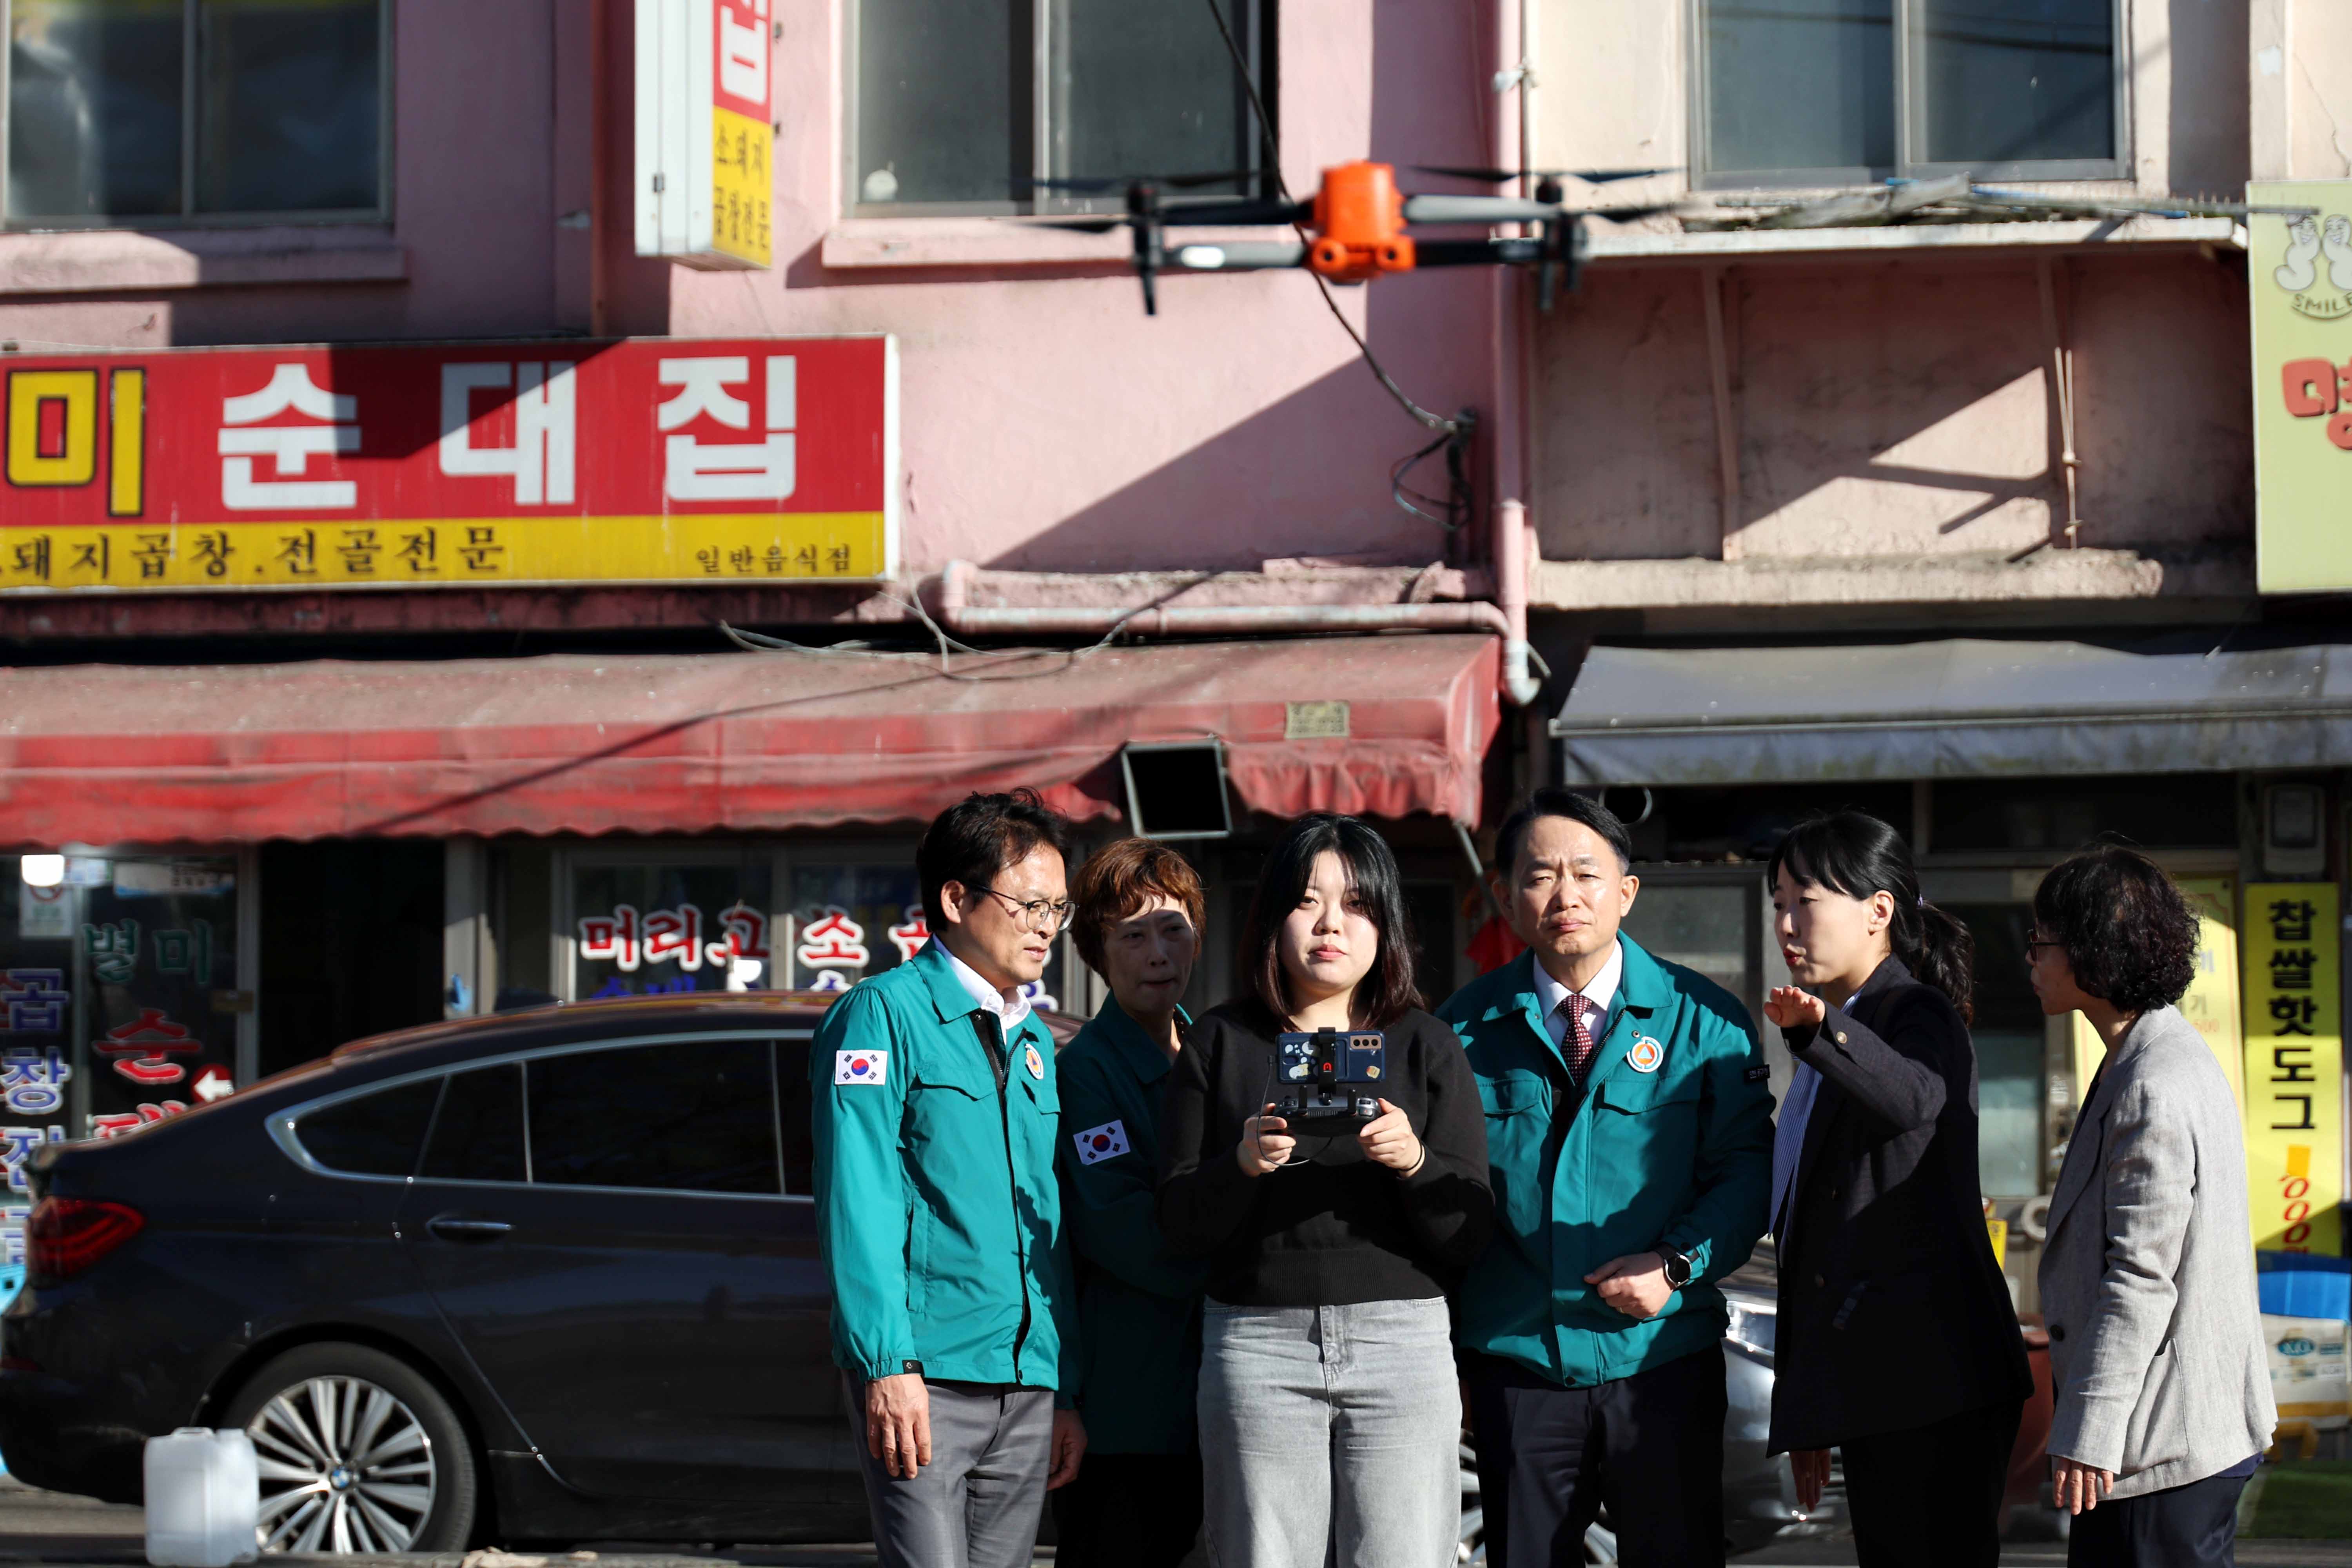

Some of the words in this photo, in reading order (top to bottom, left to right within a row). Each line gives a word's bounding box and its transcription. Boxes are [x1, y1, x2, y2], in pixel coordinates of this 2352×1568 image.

[696, 543, 851, 574] 일반음식점
[82, 918, 212, 985] 별미
[2268, 898, 2318, 1130] 찹쌀핫도그
